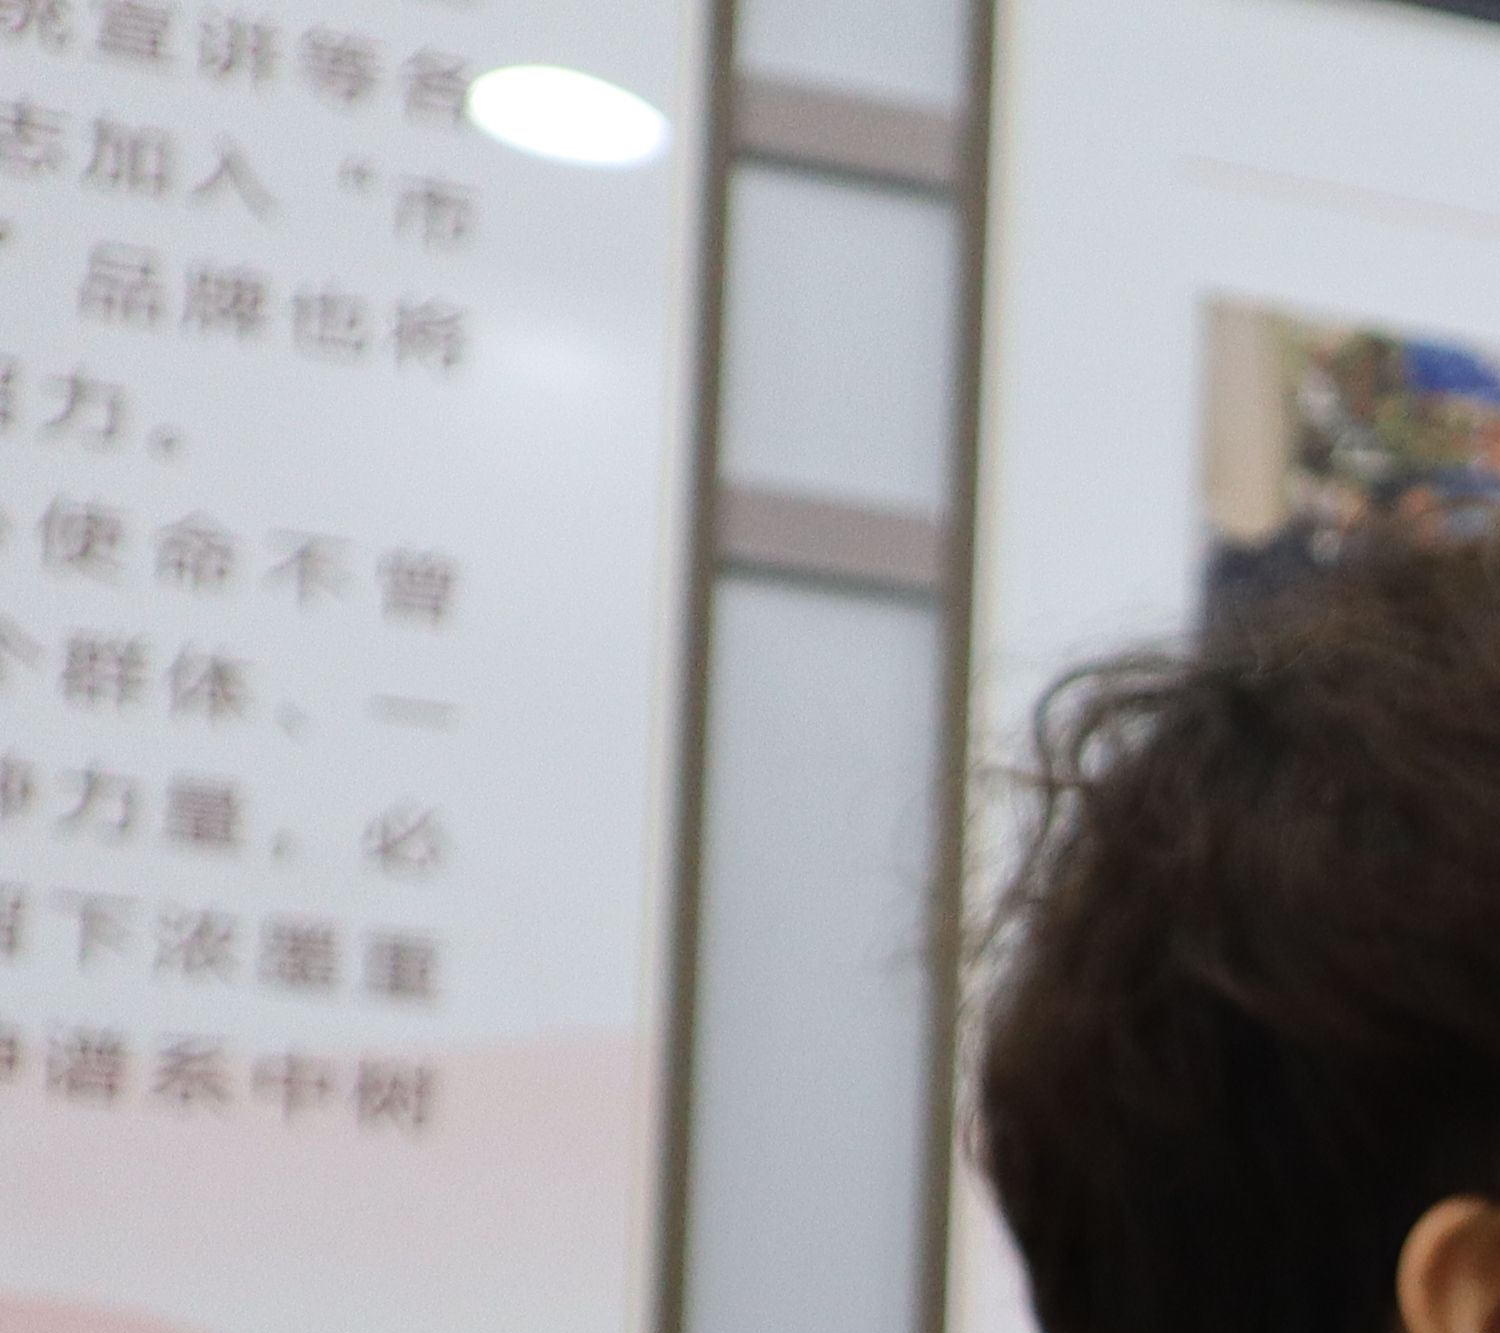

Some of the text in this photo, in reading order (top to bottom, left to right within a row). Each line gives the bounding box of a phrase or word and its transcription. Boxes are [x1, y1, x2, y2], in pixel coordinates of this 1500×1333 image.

[0, 882, 444, 1012] 下浓墨重
[0, 1022, 440, 1132] 谱系中树
